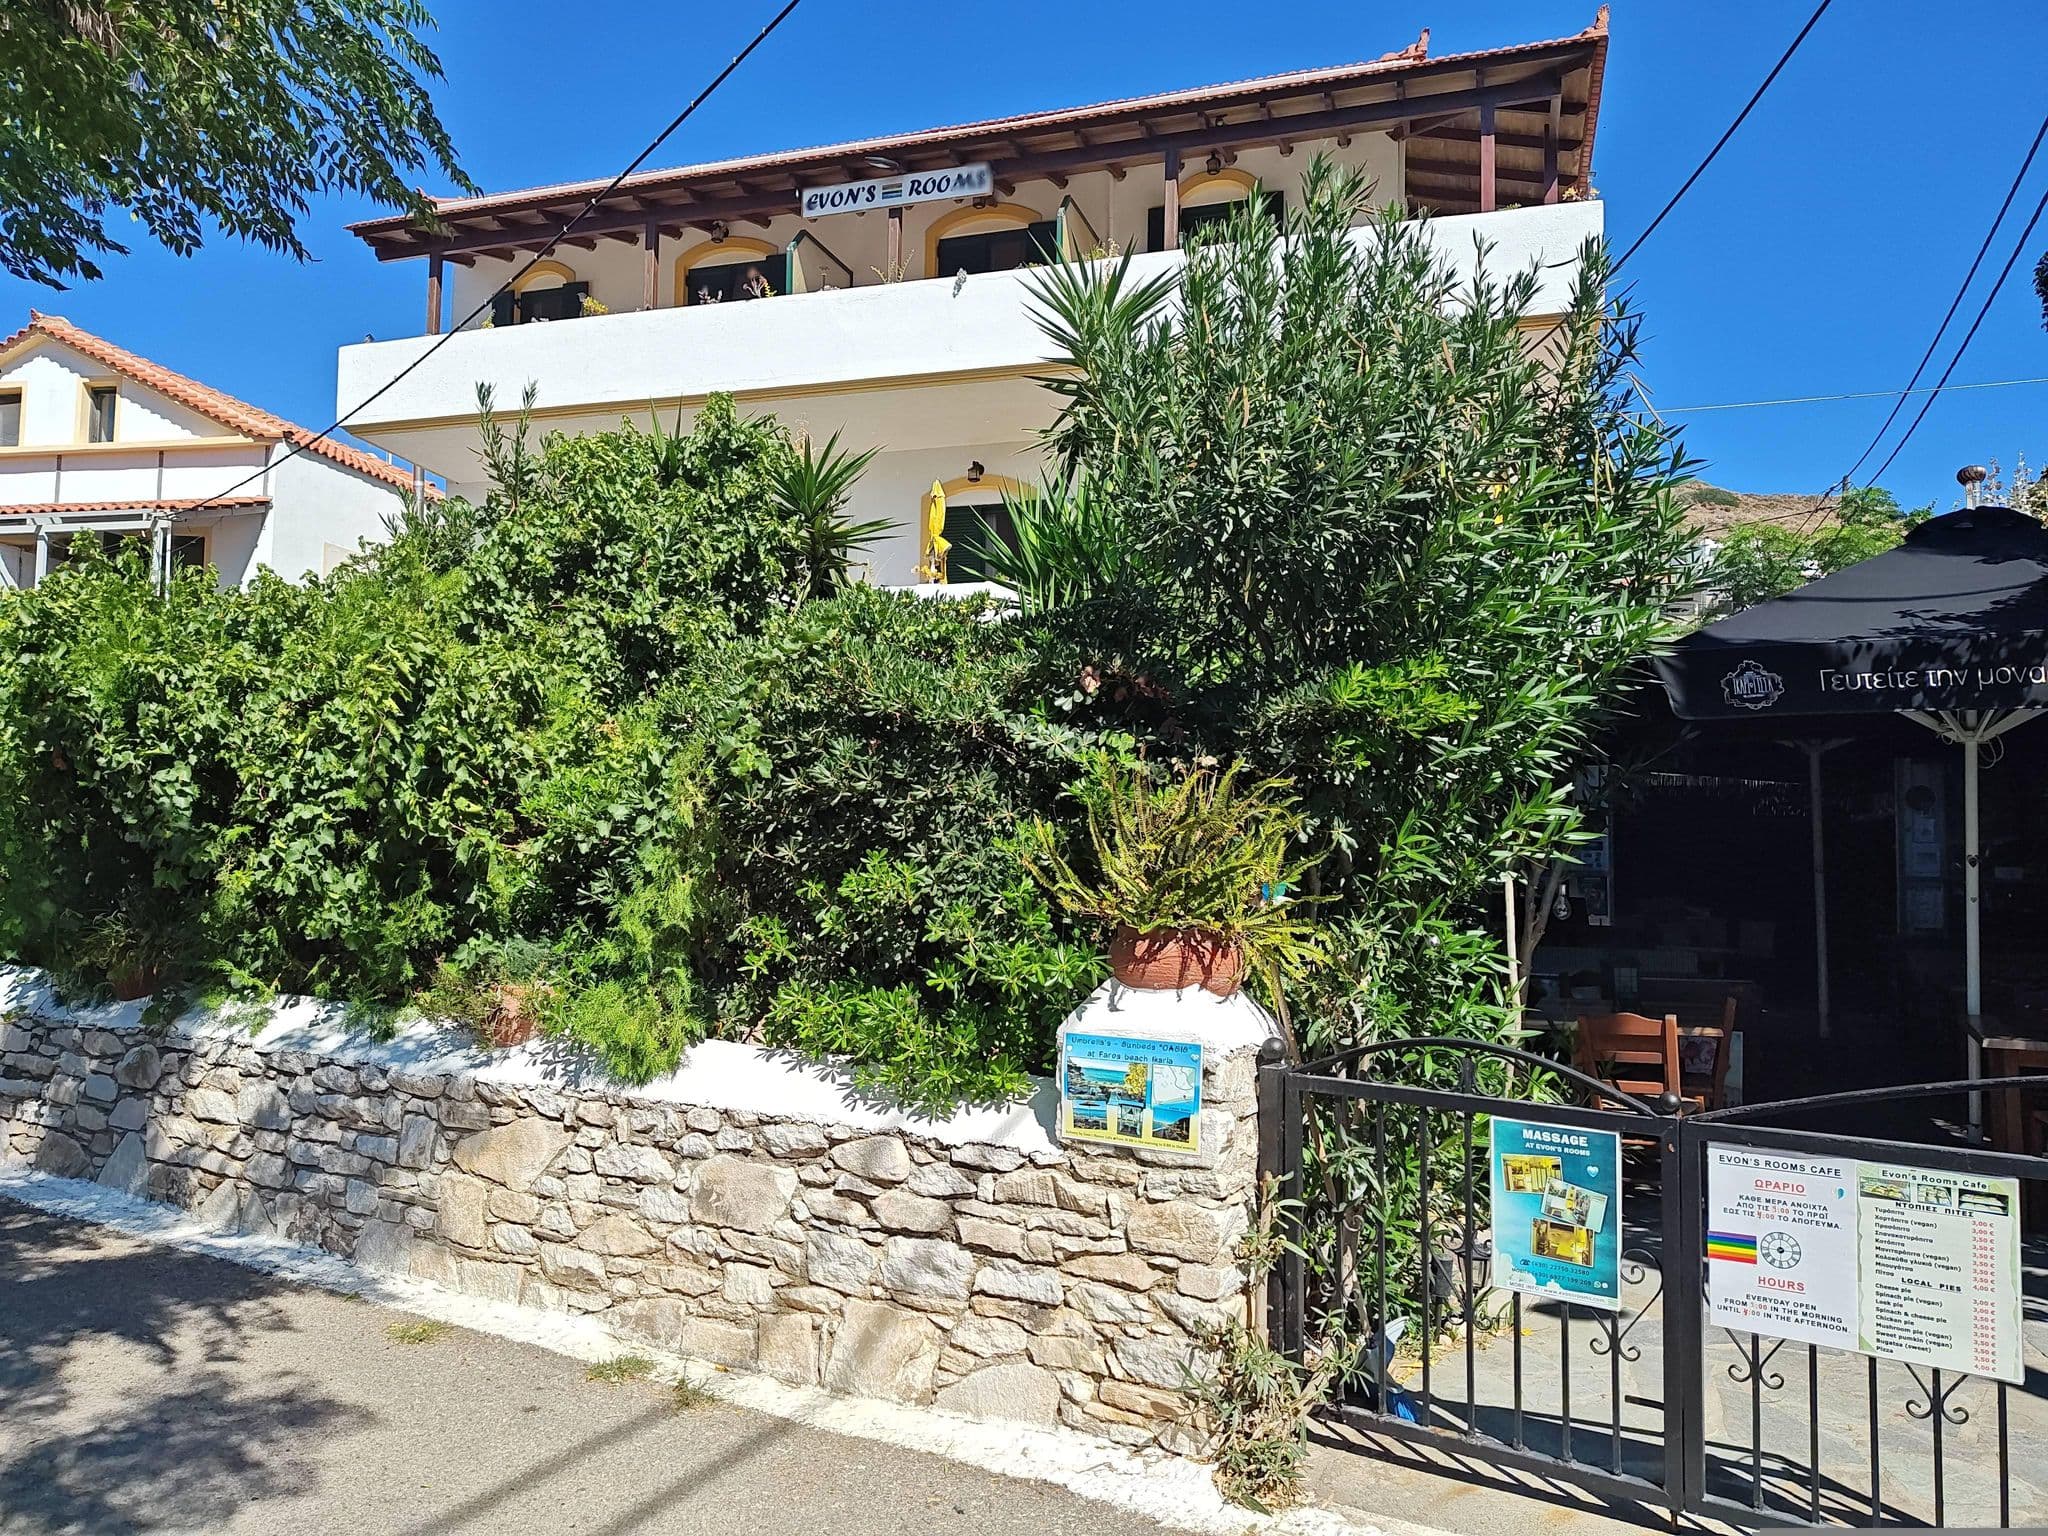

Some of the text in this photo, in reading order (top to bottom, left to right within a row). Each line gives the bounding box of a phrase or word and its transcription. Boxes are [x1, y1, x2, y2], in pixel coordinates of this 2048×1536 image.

[908, 169, 986, 197] ROOMS
[1819, 666, 1920, 691] Γευτείτε
[1925, 668, 1968, 687] την
[1124, 1054, 1148, 1062] beach
[1522, 1128, 1588, 1147] MASSAGE
[1536, 1143, 1562, 1153] EVON'S
[1563, 1147, 1591, 1157] ROOMS
[1719, 1154, 1841, 1176] EVON'S ROOMS CAFE
[1754, 1179, 1805, 1194] ΩΡΑΡΙΟ
[1882, 1169, 1987, 1190] Evon's Rooms Cafe
[1739, 1194, 1828, 1212] ΚΑΘΕ ΜΕΡΑ ΑΝΟΙΧΤΑ
[1895, 1202, 1974, 1218] ΝΤΟΠΙΕΣ ΠΙΤΕΣ
[1723, 1207, 1739, 1215] ΕΩΣ
[1778, 1214, 1789, 1222] ΤΟ
[1792, 1209, 1804, 1217] ΤΟ
[1910, 1219, 1938, 1229] (vegan)
[1922, 1253, 1950, 1263] (vegan)
[1934, 1262, 1962, 1272] (vegan)
[1758, 1276, 1805, 1292] HOURS
[1875, 1283, 1899, 1291] Cheese
[1901, 1277, 1962, 1292] LOCAL PIES
[1746, 1294, 1817, 1311] EVERYDAY OPEN
[1875, 1291, 1902, 1300] Spinach
[1915, 1297, 1943, 1308] (vegan)
[1717, 1304, 1741, 1314] UNTIL
[1775, 1314, 1791, 1322] THE
[1724, 1298, 1748, 1307] FROM
[1782, 1307, 1798, 1316] THE
[1802, 1312, 1843, 1324] MORNING
[1876, 1306, 1902, 1316] Spinach
[1911, 1313, 1935, 1321] cheese
[1876, 1314, 1902, 1323] Chicken
[1876, 1322, 1911, 1333] Mushroom
[1925, 1331, 1952, 1341] (vegan)
[1876, 1330, 1897, 1338] Sweet
[1925, 1339, 1953, 1349] (vegan)
